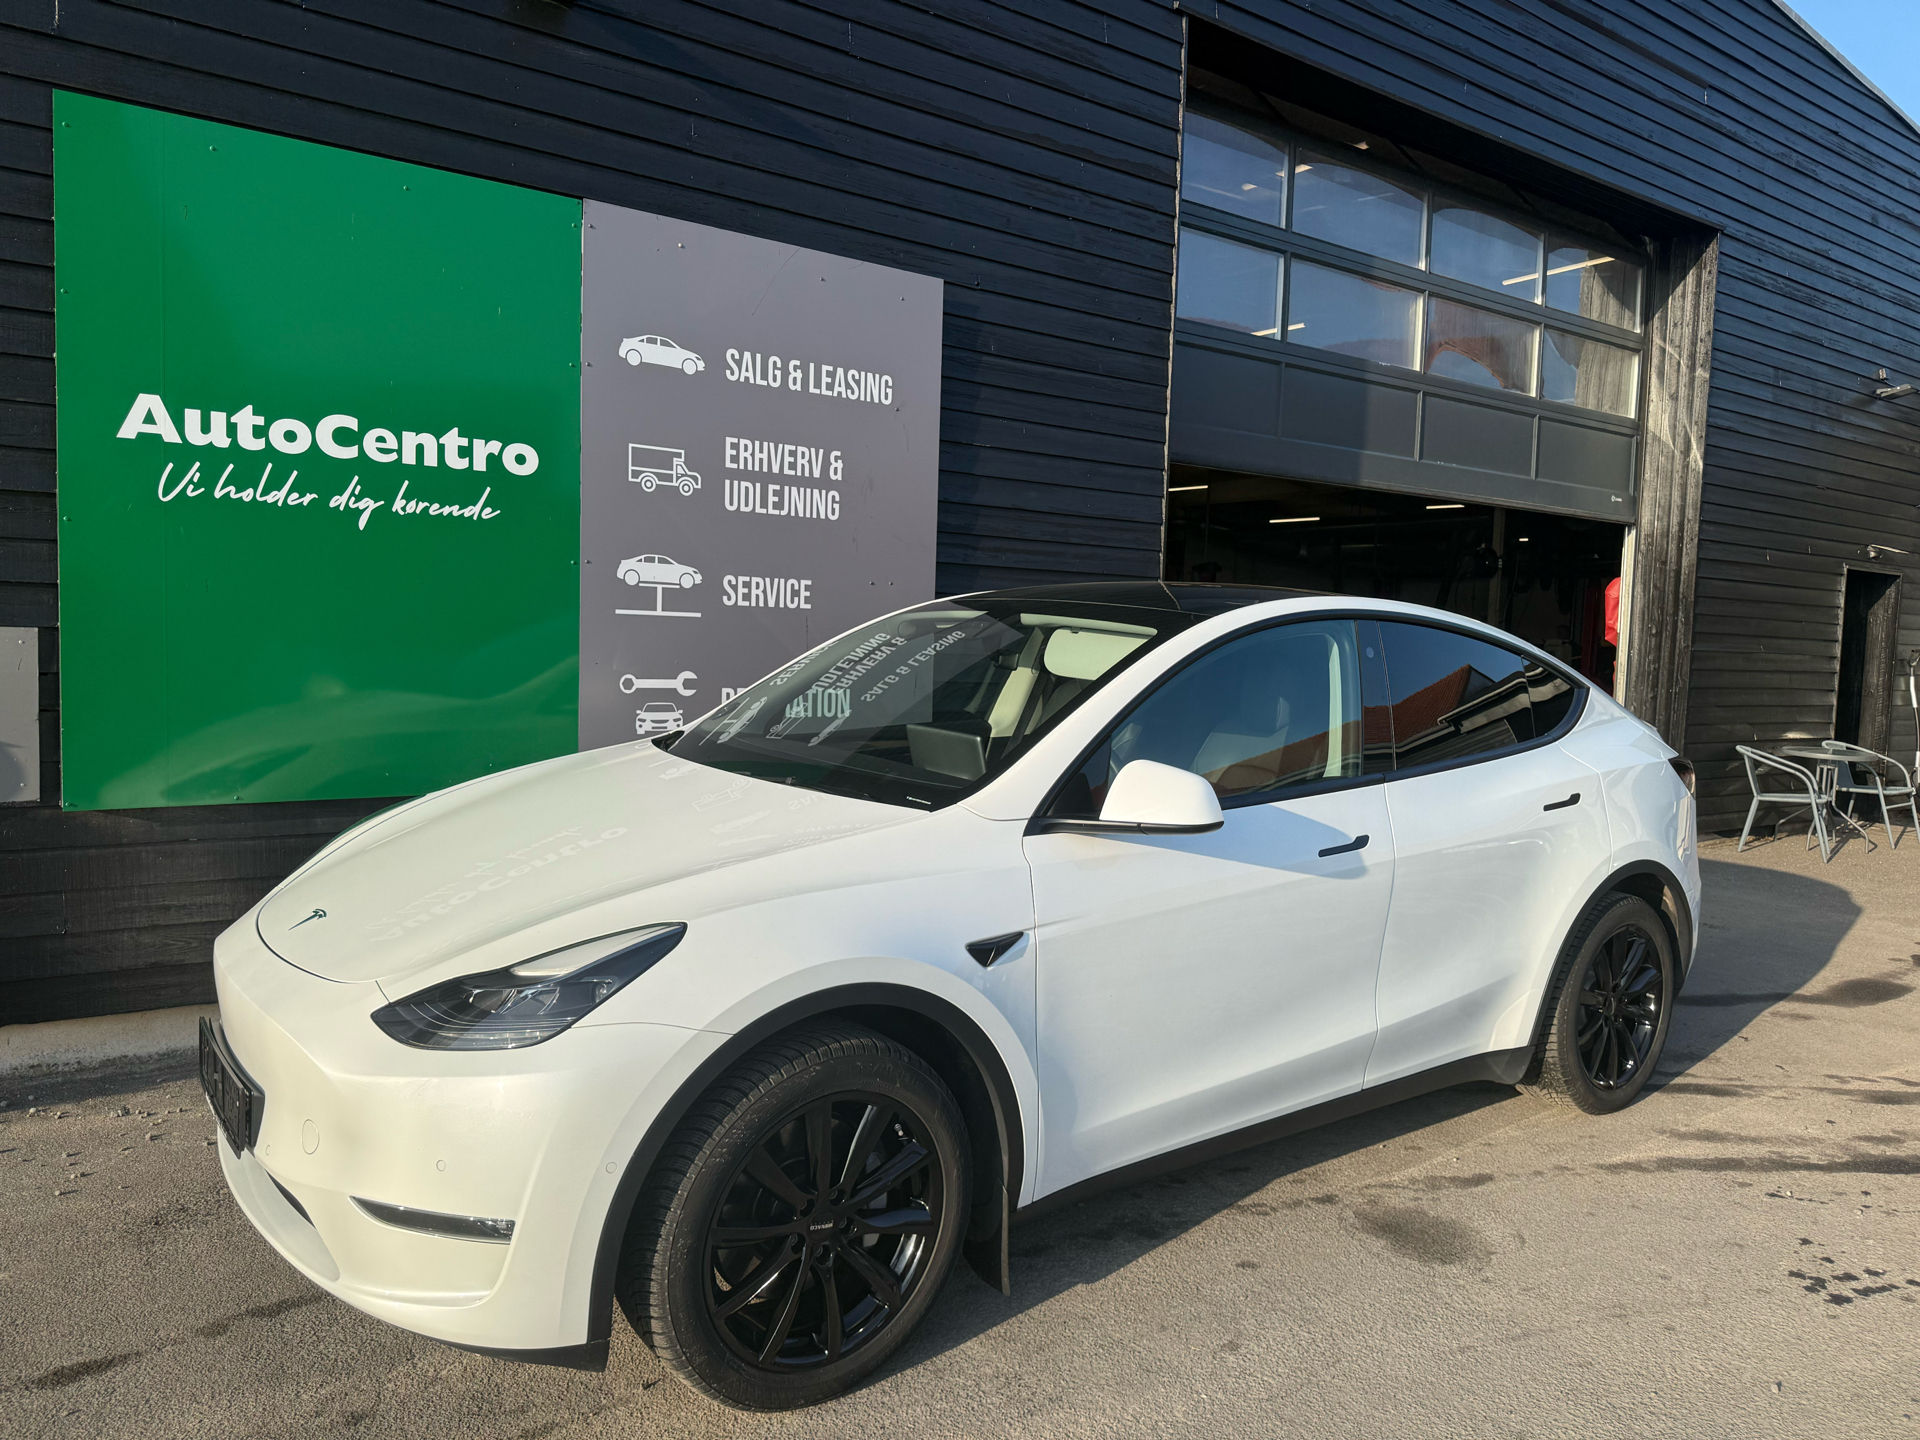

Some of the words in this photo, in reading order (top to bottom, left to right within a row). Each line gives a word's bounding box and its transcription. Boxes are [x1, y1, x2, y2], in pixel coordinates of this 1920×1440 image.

[725, 348, 782, 388] SALG
[788, 359, 803, 392] &
[808, 362, 893, 406] LEASING
[115, 392, 540, 476] AutoCentro
[725, 436, 824, 480] ERHVERV
[829, 450, 844, 481] &
[157, 461, 207, 502] Vi
[213, 463, 319, 508] holder
[328, 475, 386, 531] dig
[391, 479, 502, 521] kørende
[724, 479, 840, 521] UDLEJNING
[722, 574, 812, 609] SERVICE
